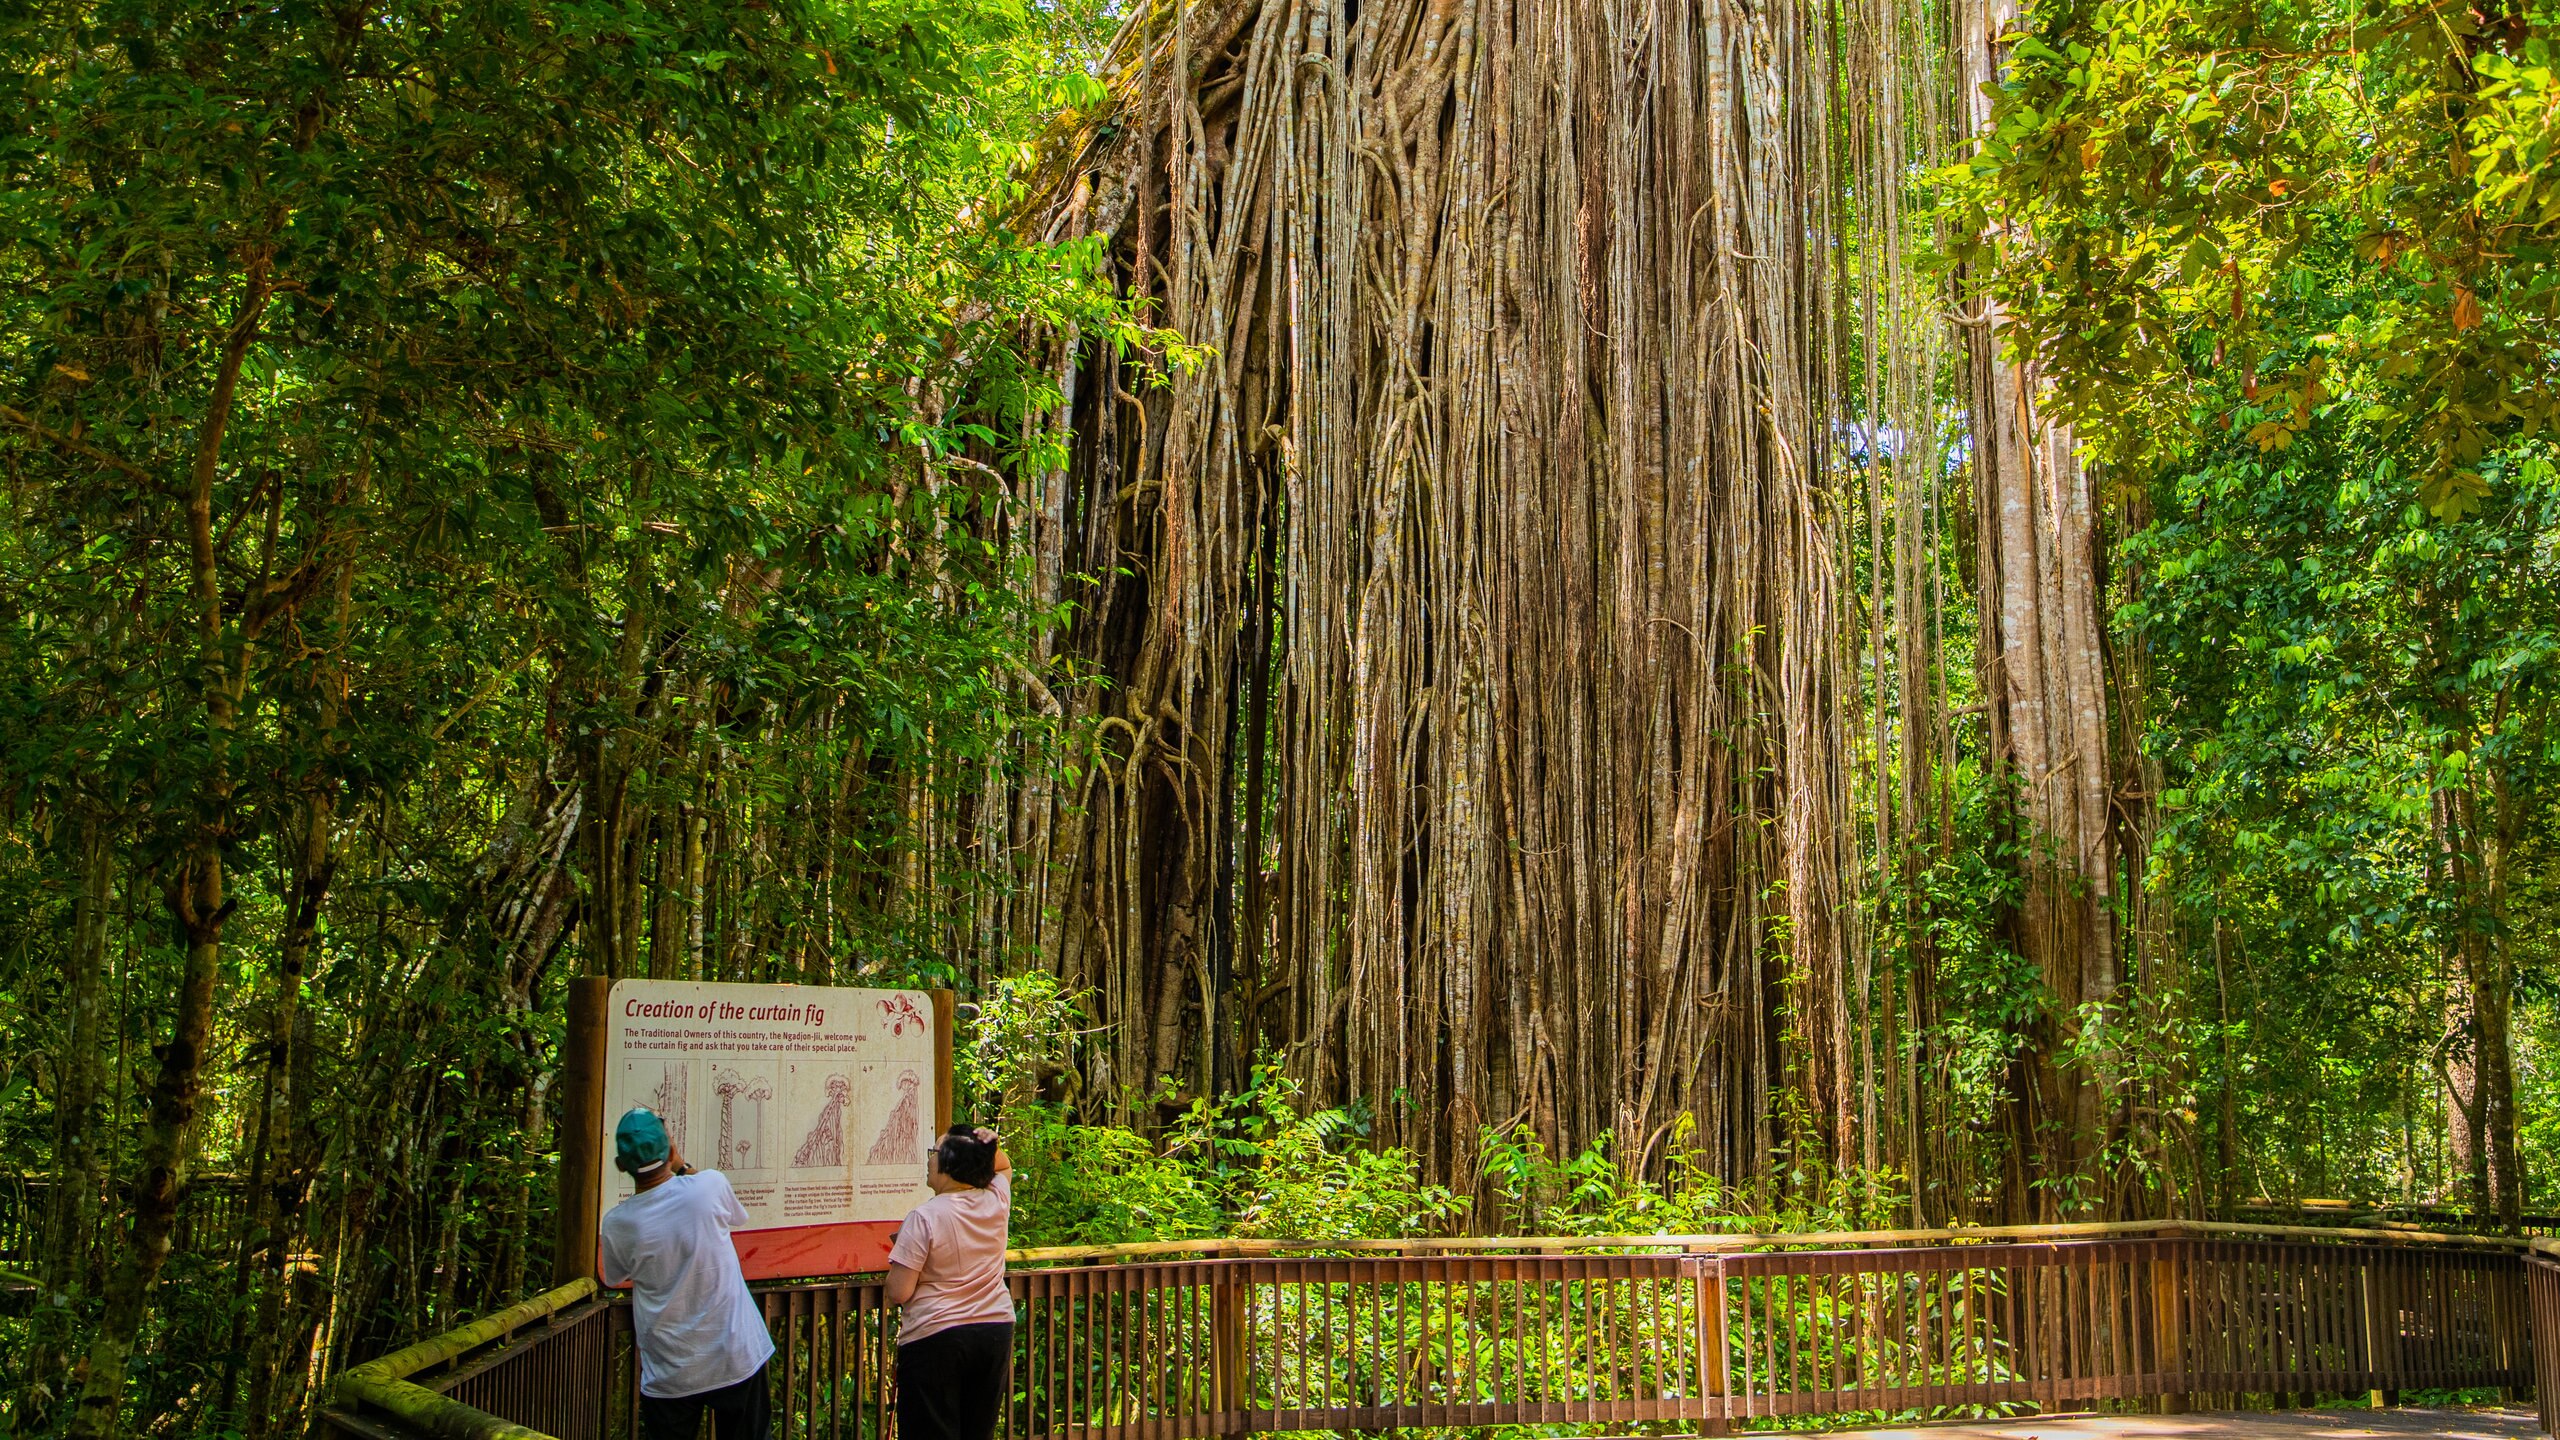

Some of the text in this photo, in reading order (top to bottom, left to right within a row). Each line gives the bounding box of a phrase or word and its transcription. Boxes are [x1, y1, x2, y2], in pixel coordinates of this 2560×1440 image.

[625, 998, 825, 1027] Creation of the curtain fig
[624, 1028, 867, 1043] The Traditional Owners of this country, the Ngadjon-Jii, welcome you
[624, 1041, 858, 1053] to the curtain fig and ask that you take care of their special place.
[628, 1063, 633, 1071] 1
[790, 1065, 795, 1073] 3
